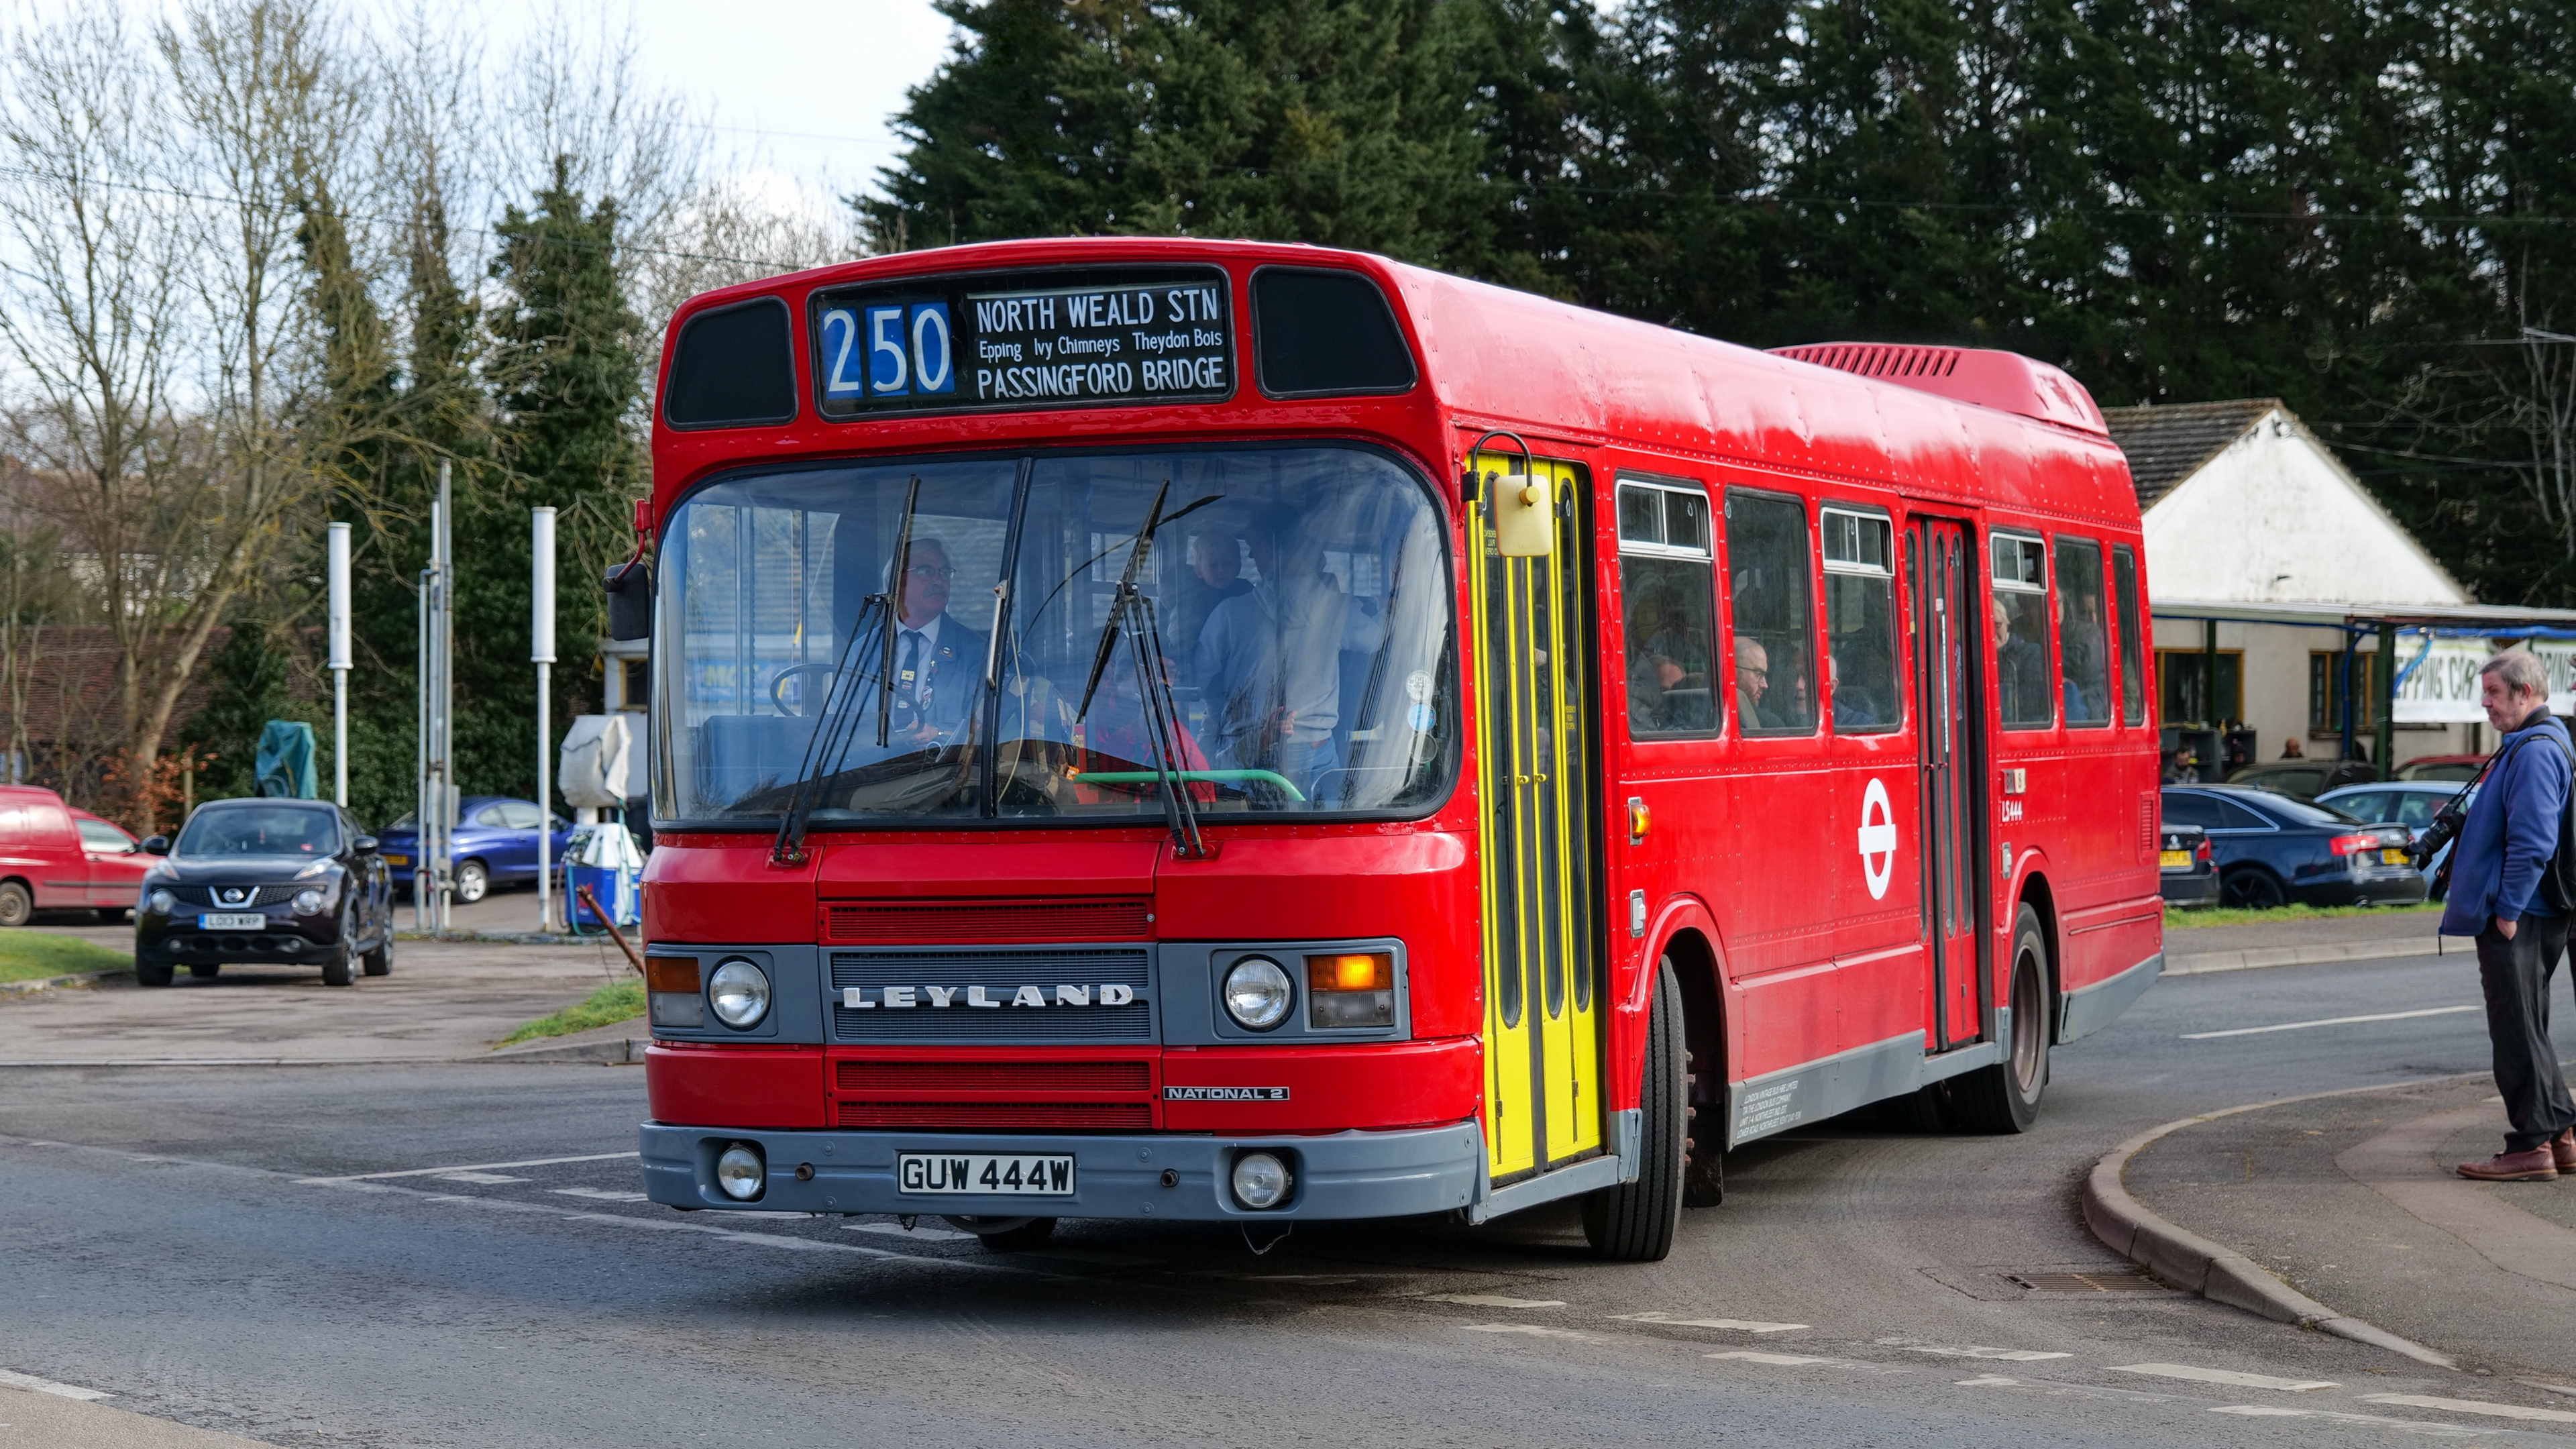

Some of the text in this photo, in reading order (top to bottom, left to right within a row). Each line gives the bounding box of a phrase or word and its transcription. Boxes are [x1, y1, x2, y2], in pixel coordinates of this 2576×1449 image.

[977, 288, 1218, 333] NORTH WEALD STN
[822, 308, 951, 392] 250
[979, 329, 1222, 363] Epping Ivy Chimneys Theydon Bois
[978, 357, 1226, 400] PASSINGFORD BRIDGE
[2002, 800, 2023, 822] LS444
[843, 984, 1133, 1008] LEYLAND
[1168, 1088, 1283, 1099] NATIONAL 2
[904, 1159, 1069, 1191] GUW 444W
